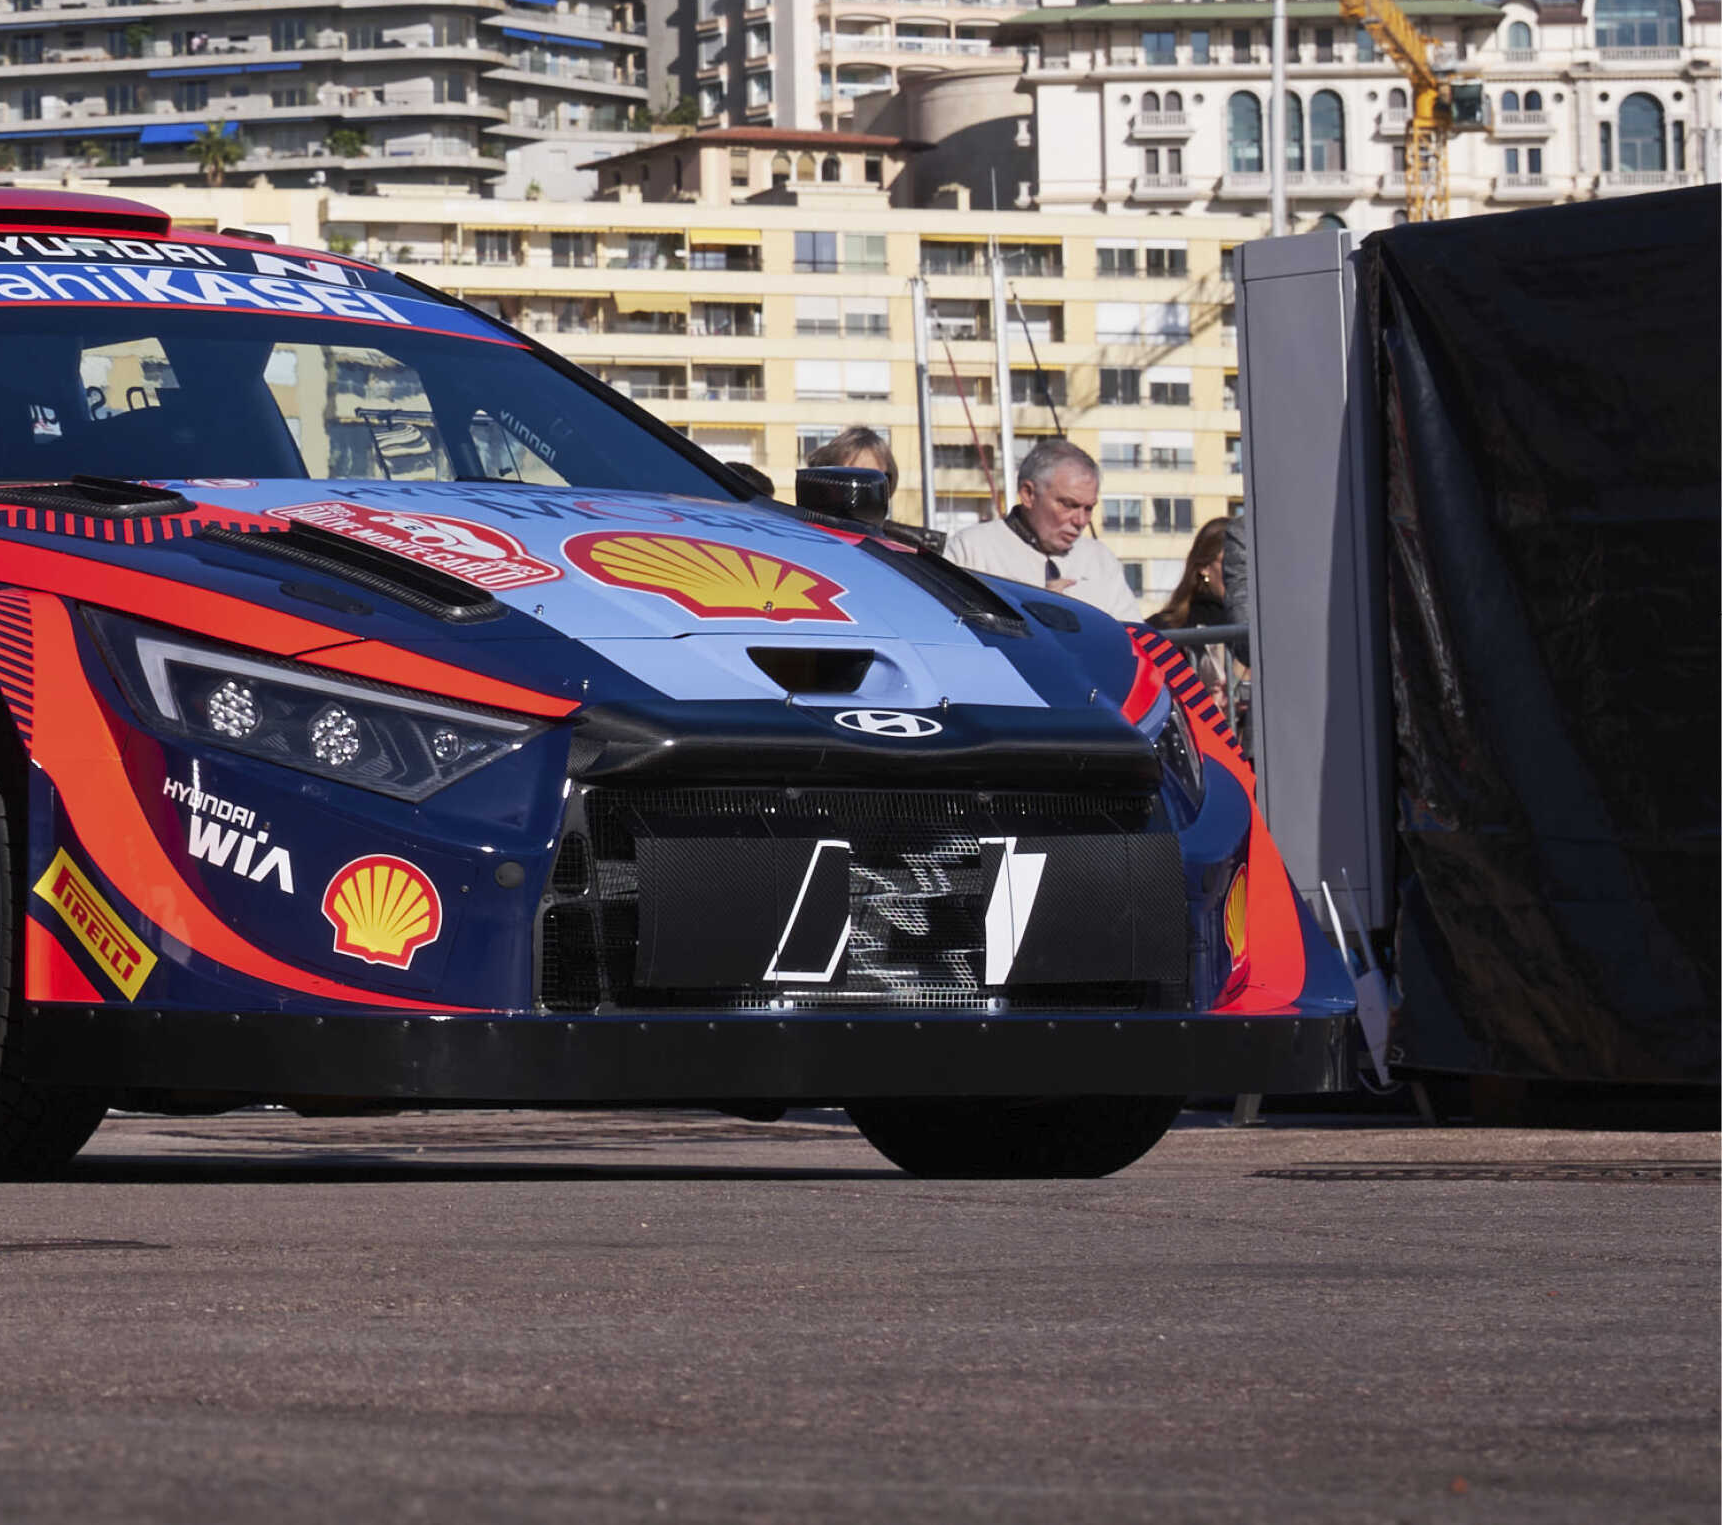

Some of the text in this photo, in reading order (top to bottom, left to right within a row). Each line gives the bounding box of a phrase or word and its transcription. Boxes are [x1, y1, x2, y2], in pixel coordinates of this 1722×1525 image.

[362, 528, 527, 585] MONTE-CARLO
[163, 777, 255, 829] HYUNDAI
[188, 814, 294, 895] WIA
[51, 865, 141, 982] PIRELLI
